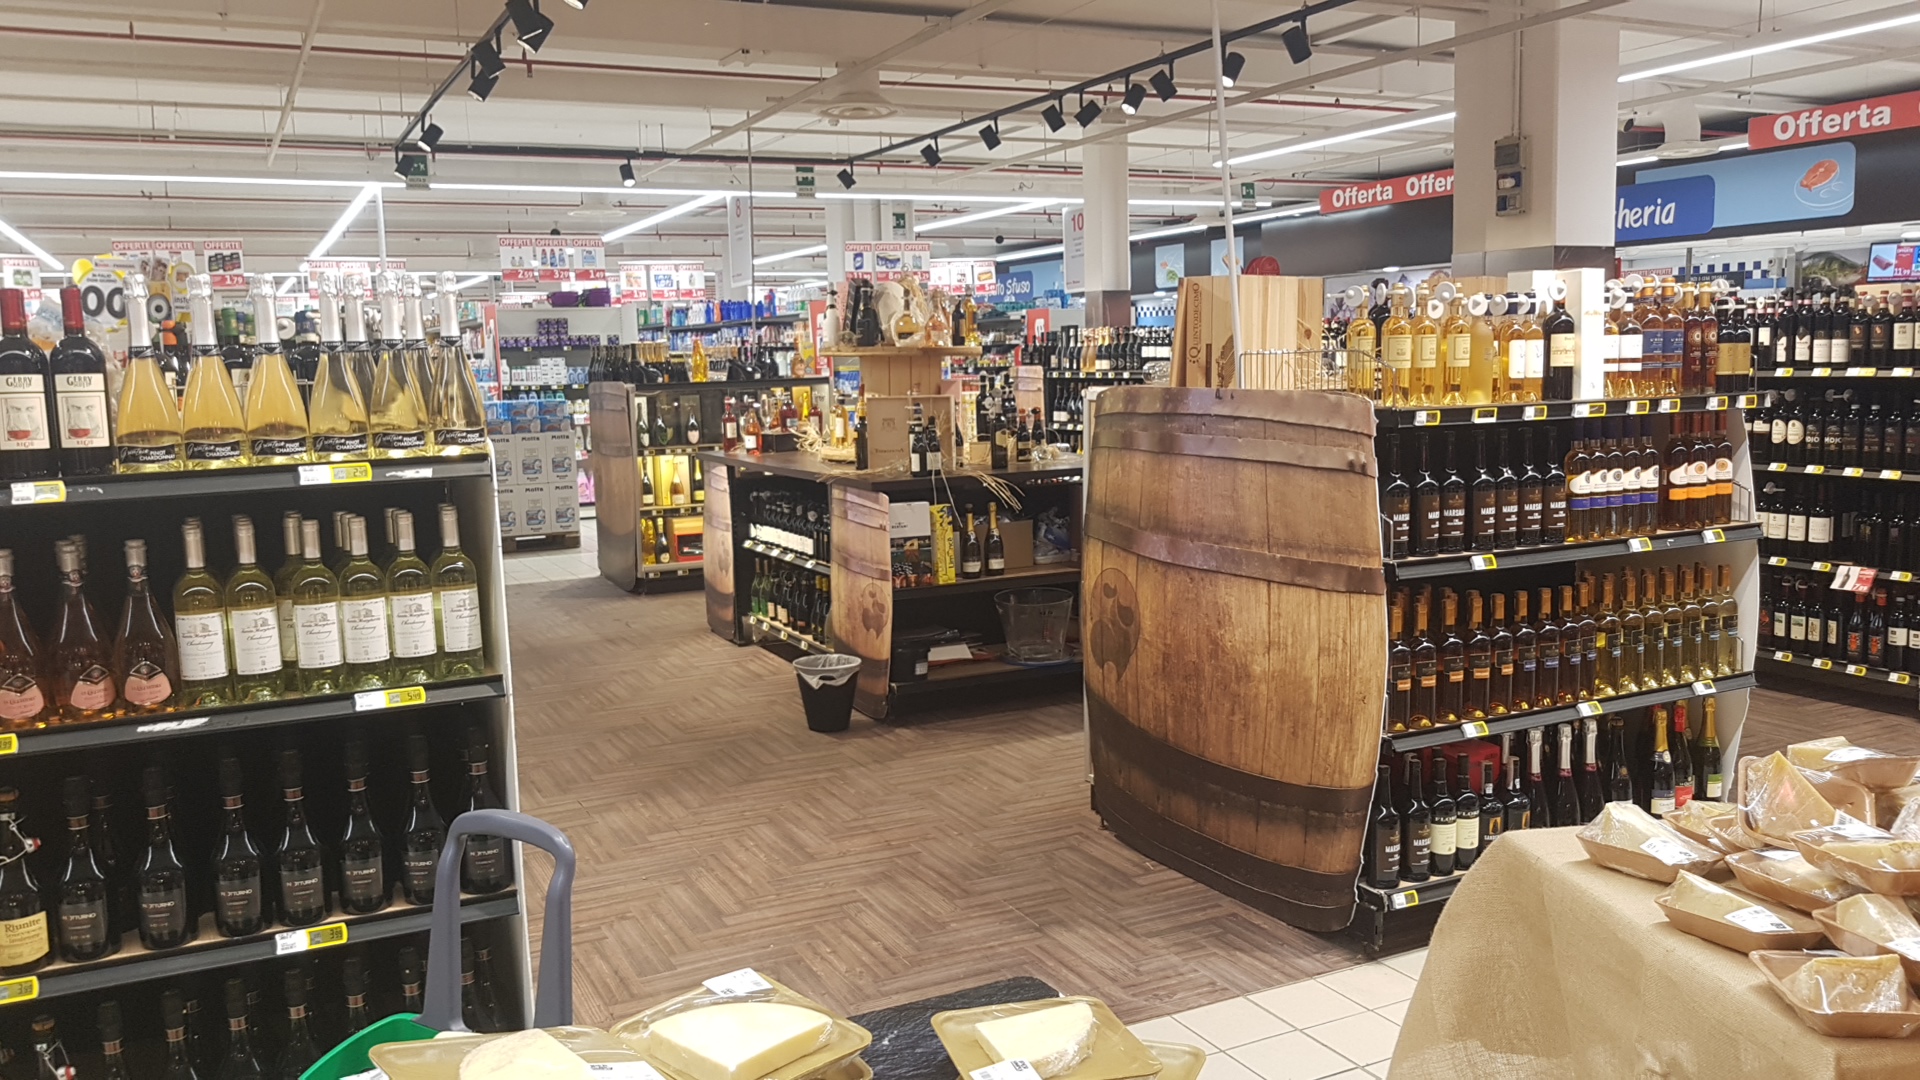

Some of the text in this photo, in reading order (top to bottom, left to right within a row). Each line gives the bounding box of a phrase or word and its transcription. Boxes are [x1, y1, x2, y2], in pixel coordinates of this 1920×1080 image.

[1773, 103, 1892, 141] Offerta
[1332, 173, 1454, 208] Offerta Offer
[1614, 197, 1676, 230] heria
[1071, 212, 1084, 232] 10
[112, 241, 150, 250] OFFERTE
[154, 241, 194, 250] OFFERTE
[204, 241, 242, 250] OFFERTE
[500, 238, 533, 246] OFFERTE
[536, 238, 567, 246] OFFERTE
[573, 238, 605, 247] OFFERTE
[1006, 277, 1031, 295] Sfuso
[1188, 283, 1202, 359] QUINTODECIMO
[6, 375, 33, 388] GERRY
[66, 375, 93, 388] GERRY
[1481, 507, 1496, 515] MARS
[4, 918, 42, 933] Riunite
